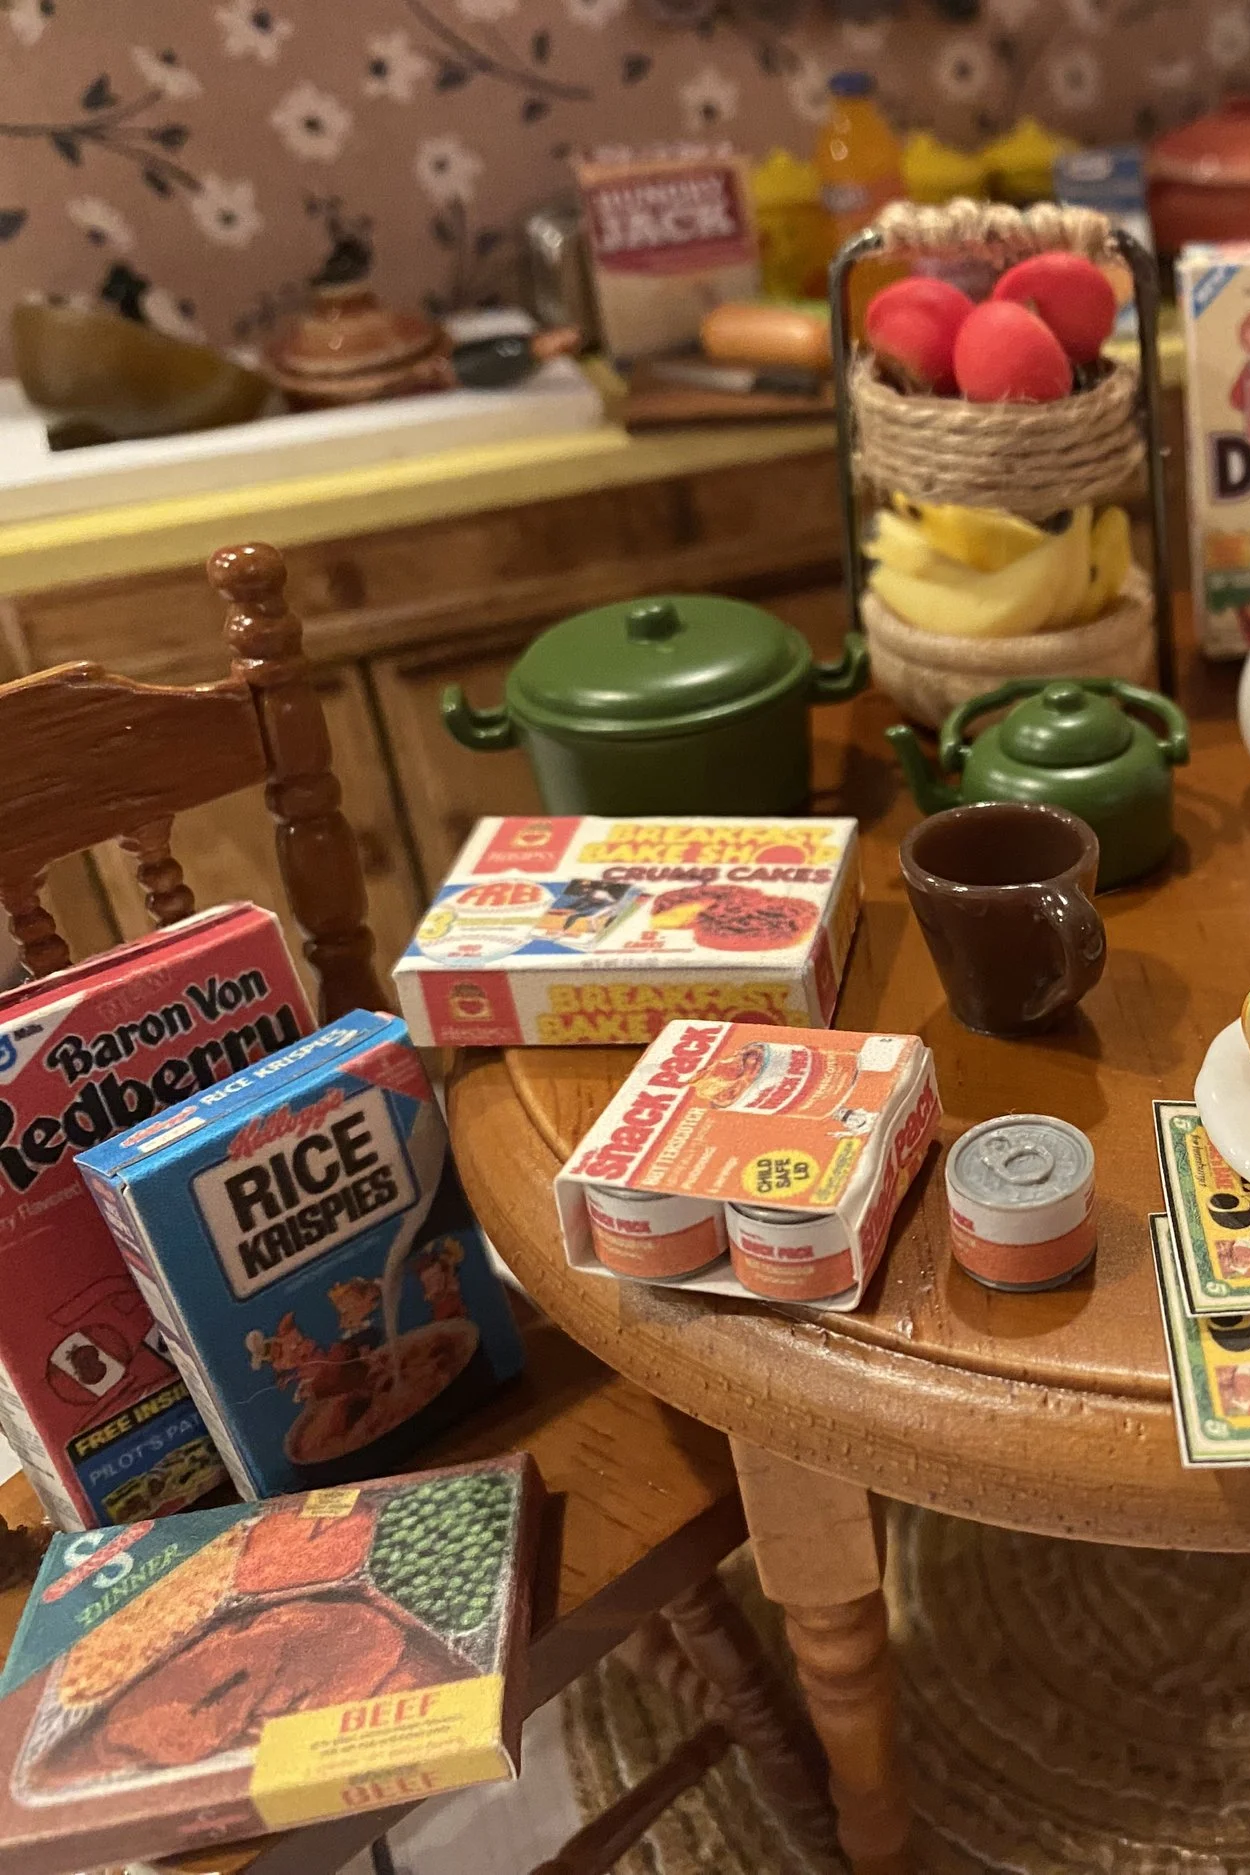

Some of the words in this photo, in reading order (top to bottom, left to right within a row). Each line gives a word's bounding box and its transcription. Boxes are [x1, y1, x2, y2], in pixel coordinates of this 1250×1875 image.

[604, 823, 835, 845] BREAKFAST
[577, 842, 683, 864] BAKE
[602, 866, 721, 883] CRUMB
[726, 866, 834, 883] CAKES
[546, 981, 791, 1013] BREAKFAST
[45, 1002, 195, 1086] Baron
[183, 968, 271, 1024] Von
[536, 1011, 650, 1044] BAKE
[201, 1076, 254, 1106] RICE
[253, 1027, 348, 1079] KRISPIES
[1176, 1116, 1194, 1132] 5
[223, 1111, 382, 1234] RICE
[756, 1157, 774, 1194] CHILD
[774, 1156, 793, 1190] SAFE
[238, 1164, 399, 1279] KRISPIES
[1206, 1281, 1228, 1297] 5
[75, 1414, 131, 1458] FREE
[132, 1378, 191, 1426] INSI
[1205, 1418, 1228, 1437] 5
[339, 1691, 440, 1734] BEEF
[342, 1770, 439, 1807] BEEF
